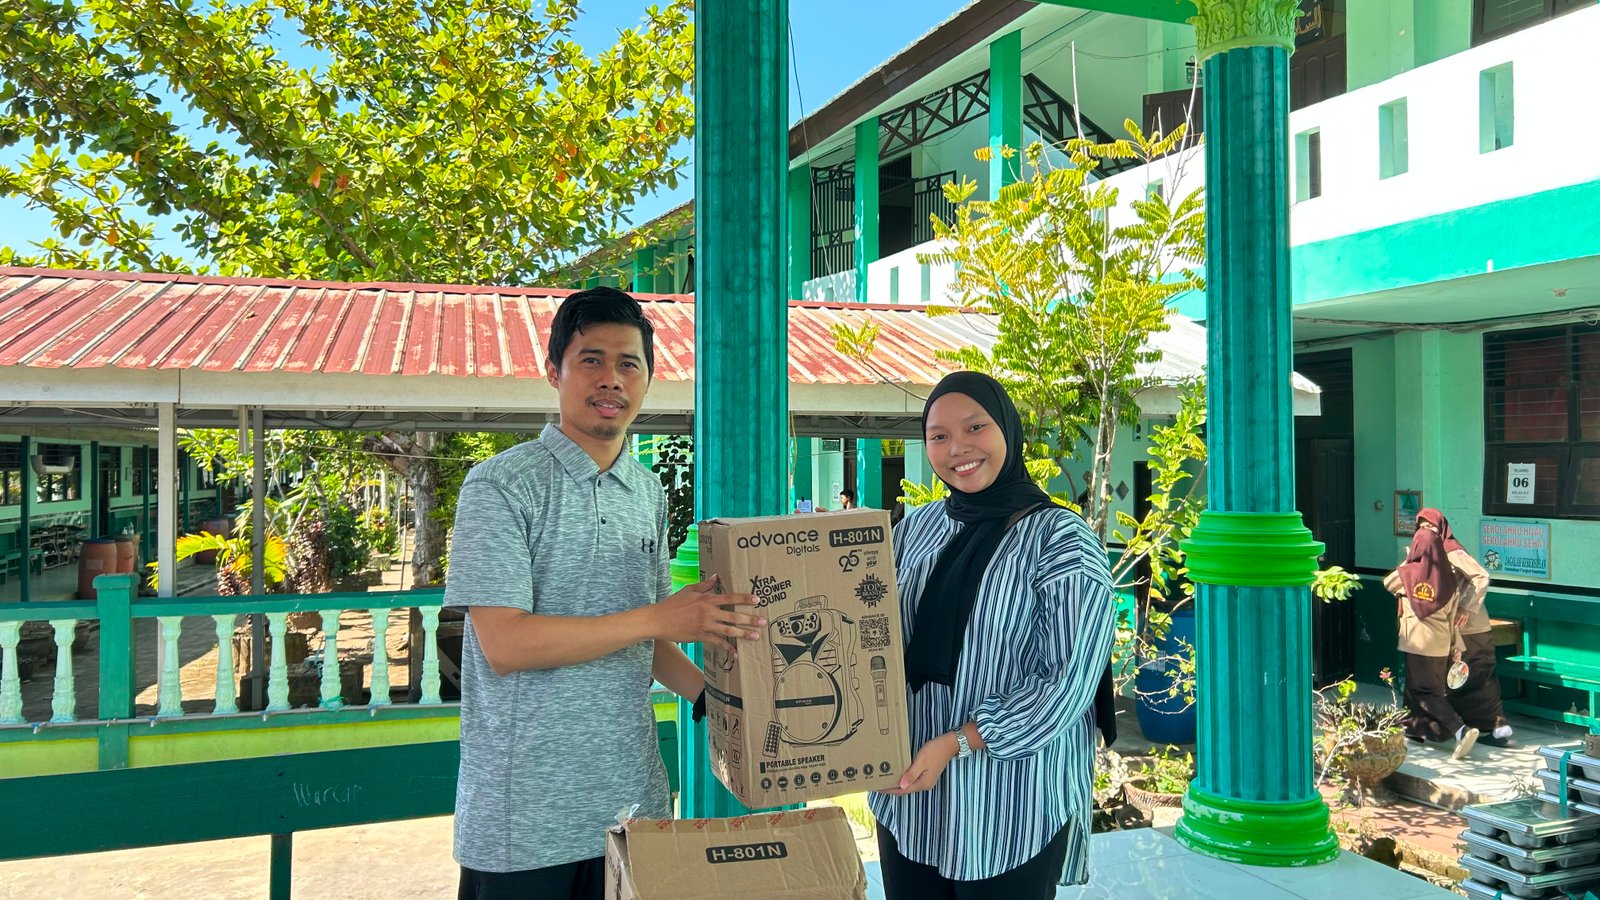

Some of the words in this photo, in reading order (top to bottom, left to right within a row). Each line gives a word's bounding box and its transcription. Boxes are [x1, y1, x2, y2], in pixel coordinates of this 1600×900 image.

[1513, 477, 1529, 488] 06
[1482, 524, 1522, 537] SEKOLAHKU
[1523, 527, 1545, 537] HIJAU
[737, 529, 819, 549] advance
[833, 529, 881, 545] H-801N
[1482, 535, 1522, 548] SEKOLAHKU
[786, 544, 820, 556] Digitals
[749, 575, 777, 595] XTRA
[756, 580, 792, 597] POWER
[766, 758, 797, 769] PORTABLE
[797, 754, 825, 765] SPEAKER
[711, 844, 782, 861] H-801N
